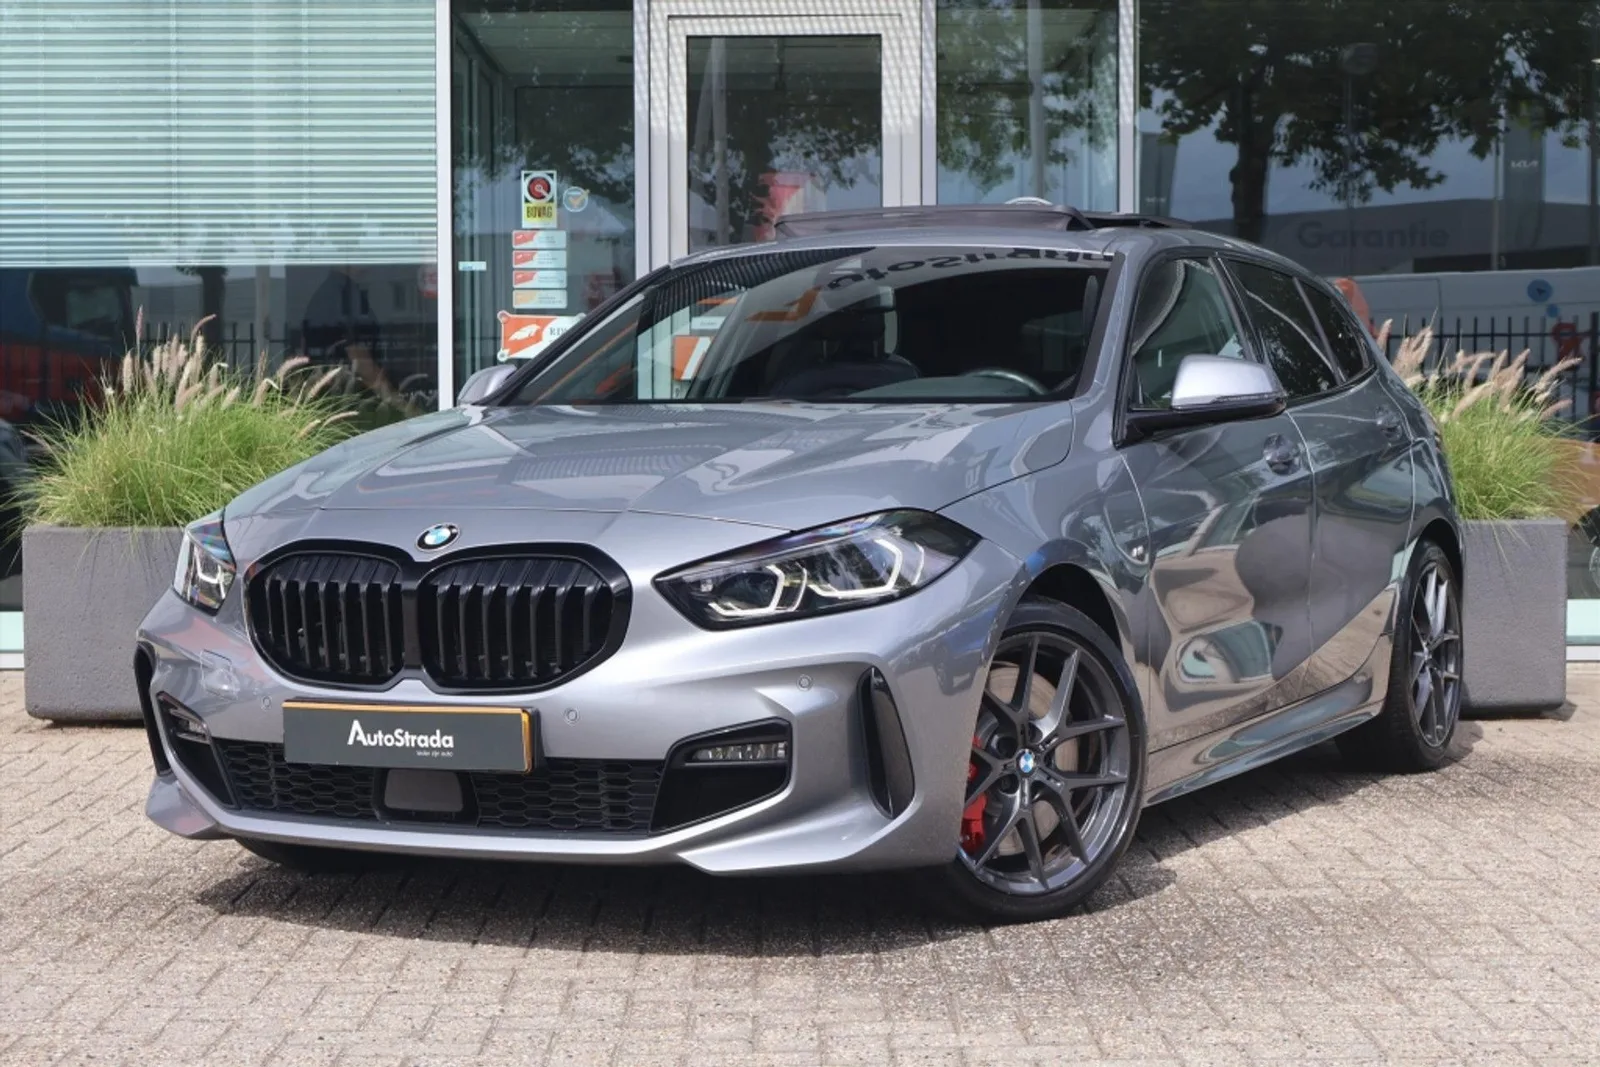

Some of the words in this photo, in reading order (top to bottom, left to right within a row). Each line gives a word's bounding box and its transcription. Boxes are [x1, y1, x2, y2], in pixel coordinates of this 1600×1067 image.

[526, 206, 553, 218] BOVAG
[1297, 219, 1451, 249] Garantie
[347, 719, 454, 748] AutoStrada
